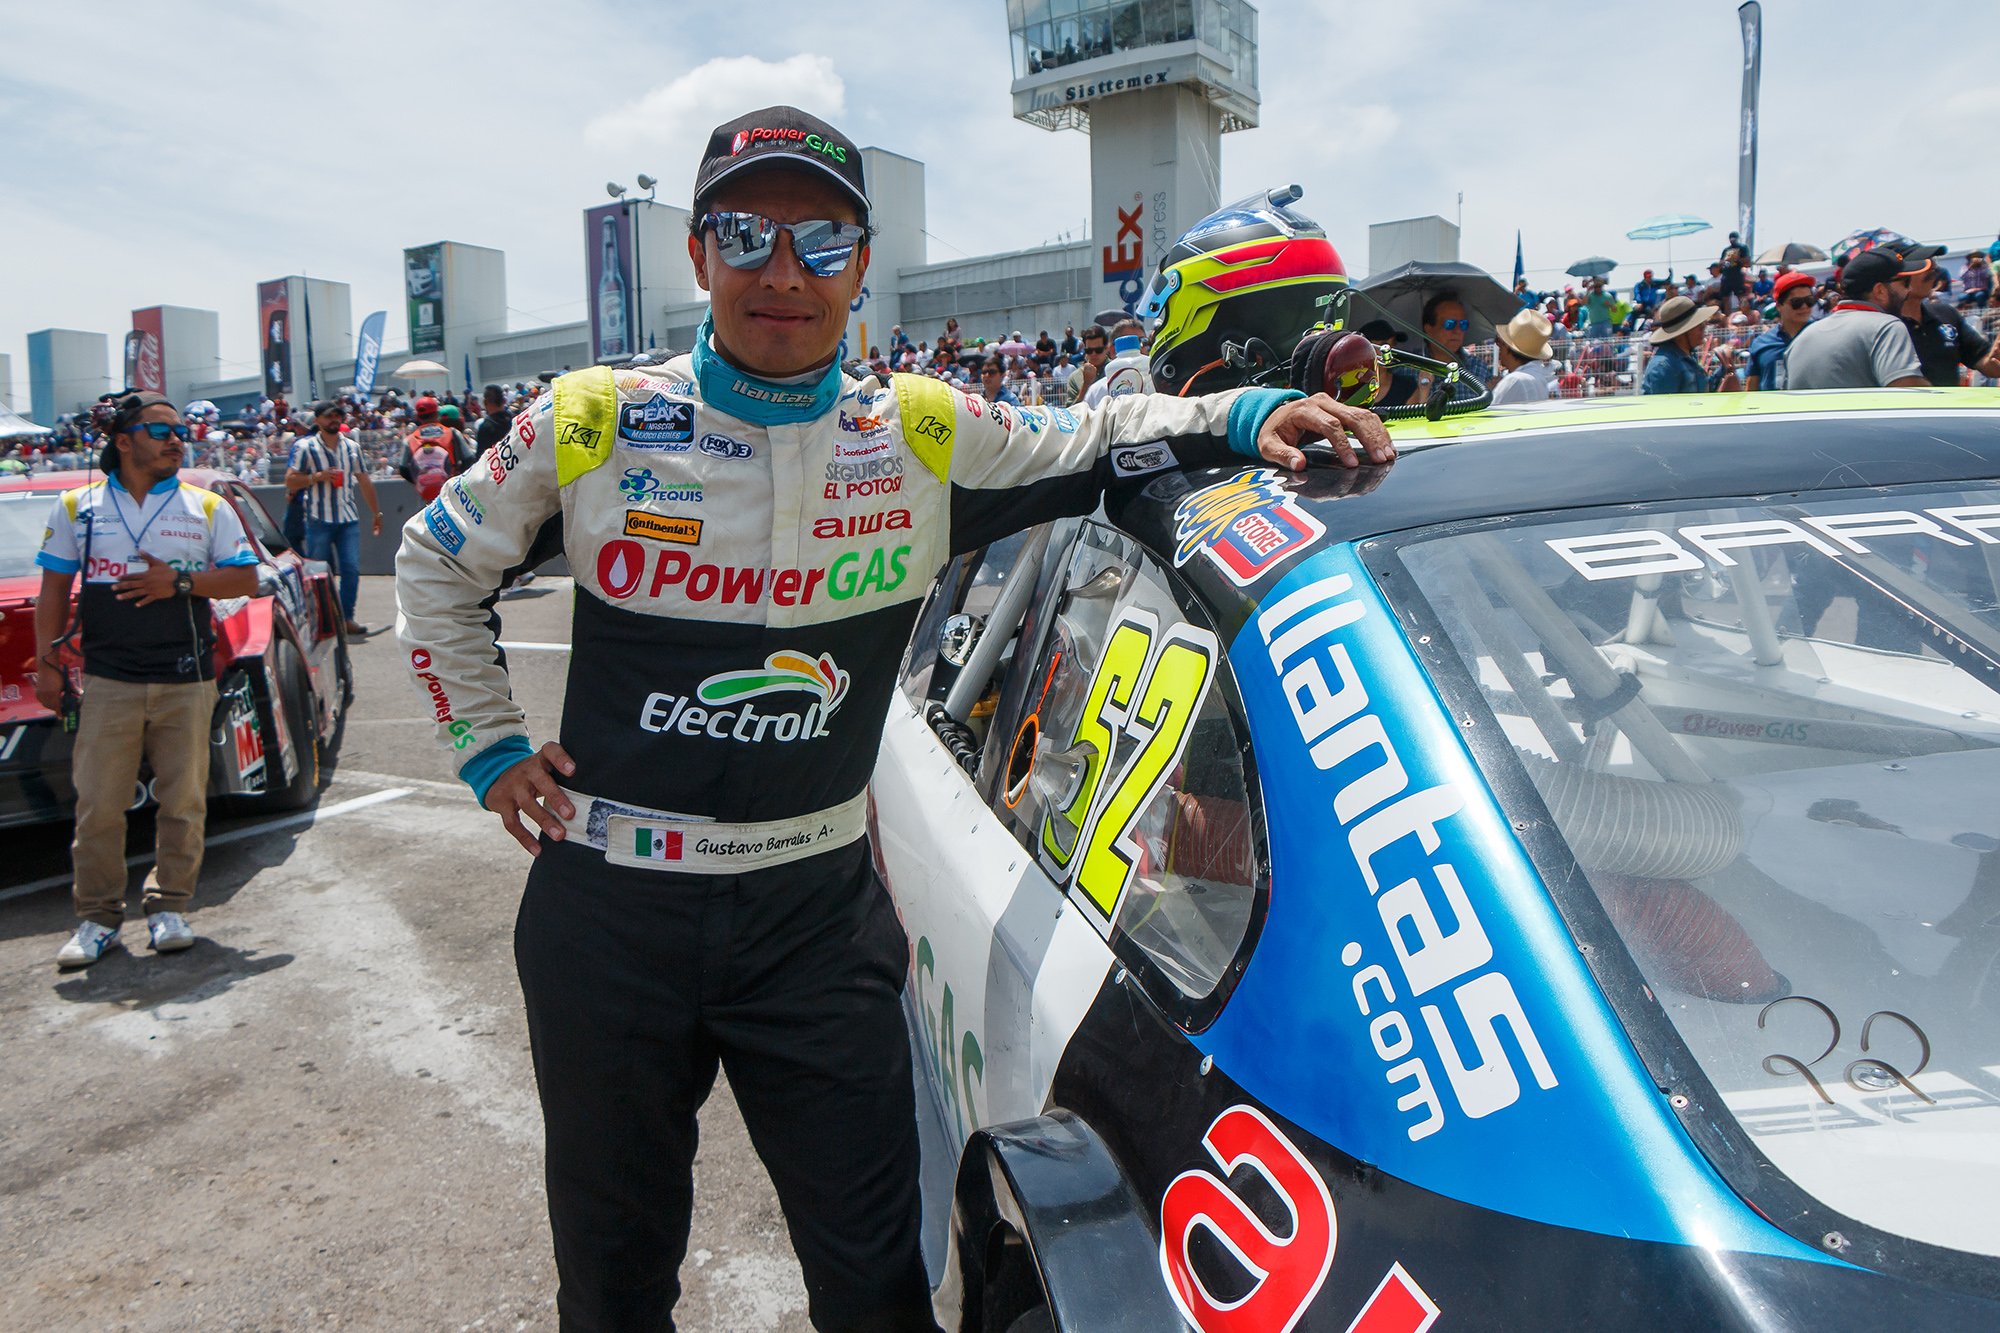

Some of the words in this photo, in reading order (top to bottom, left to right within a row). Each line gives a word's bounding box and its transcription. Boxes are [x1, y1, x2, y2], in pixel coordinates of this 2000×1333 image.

[1066, 70, 1168, 101] Sisttemex
[750, 128, 847, 164] PowerGAS
[731, 379, 817, 404] llantas
[629, 404, 688, 425] PEAK
[647, 422, 675, 430] NASCAR
[838, 410, 881, 433] FedEx
[559, 423, 602, 449] K1
[915, 415, 953, 446] K1
[706, 437, 730, 450] FOX
[738, 446, 749, 456] 3
[843, 442, 889, 457] Scotiabank
[825, 457, 904, 482] SEGUROS
[652, 490, 704, 502] TEQUIS
[824, 483, 841, 500] EL
[847, 475, 904, 499] POTOSI
[160, 528, 203, 541] aiwa
[628, 516, 689, 532] Continental
[812, 508, 913, 539] aiwa
[1233, 513, 1288, 557] STORE
[649, 545, 912, 606] PowerGAS
[1703, 716, 1809, 742] PowerGAS
[1040, 605, 1220, 942] 52
[695, 838, 763, 856] Gustavo
[766, 832, 812, 851] Barrales
[1258, 574, 1559, 1119] llantas
[1341, 941, 1445, 1142] .com
